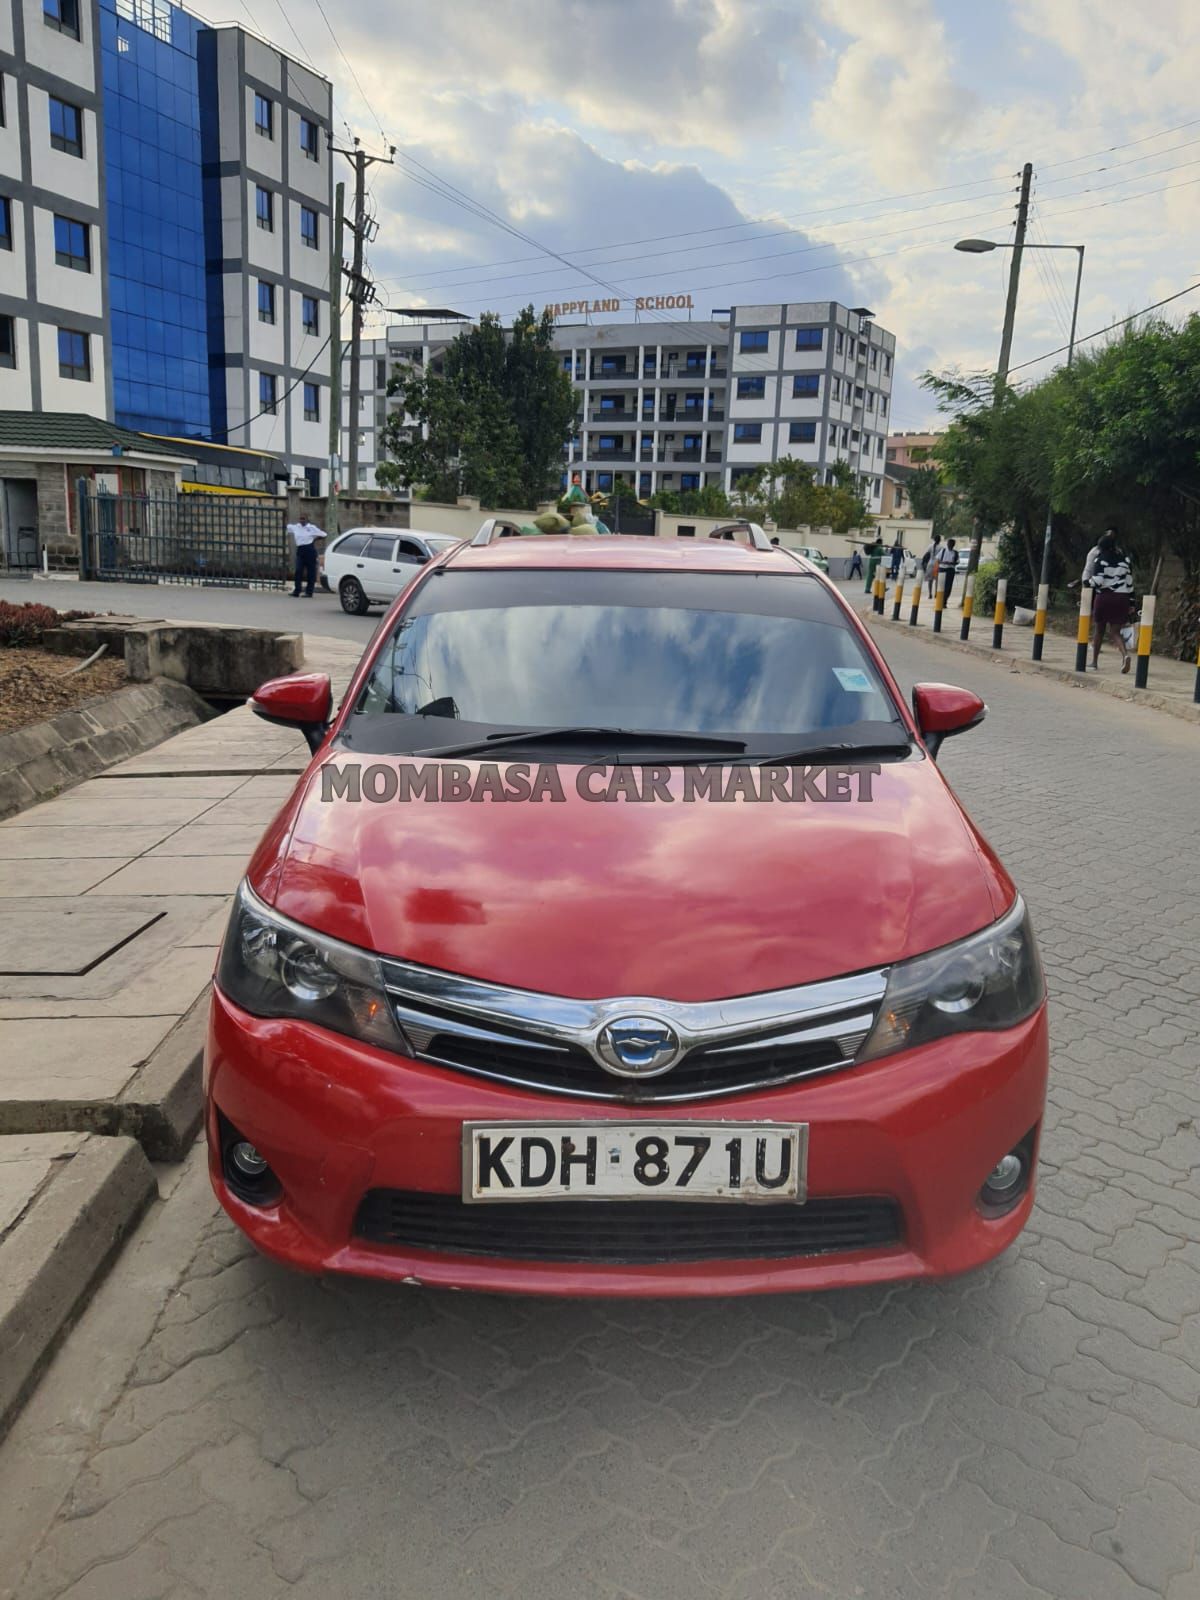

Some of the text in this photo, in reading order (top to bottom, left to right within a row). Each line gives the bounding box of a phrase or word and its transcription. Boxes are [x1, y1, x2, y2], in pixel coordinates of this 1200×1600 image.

[545, 295, 694, 316] HAPPYLAND SCHOOL
[478, 1135, 793, 1188] KDH 871U
